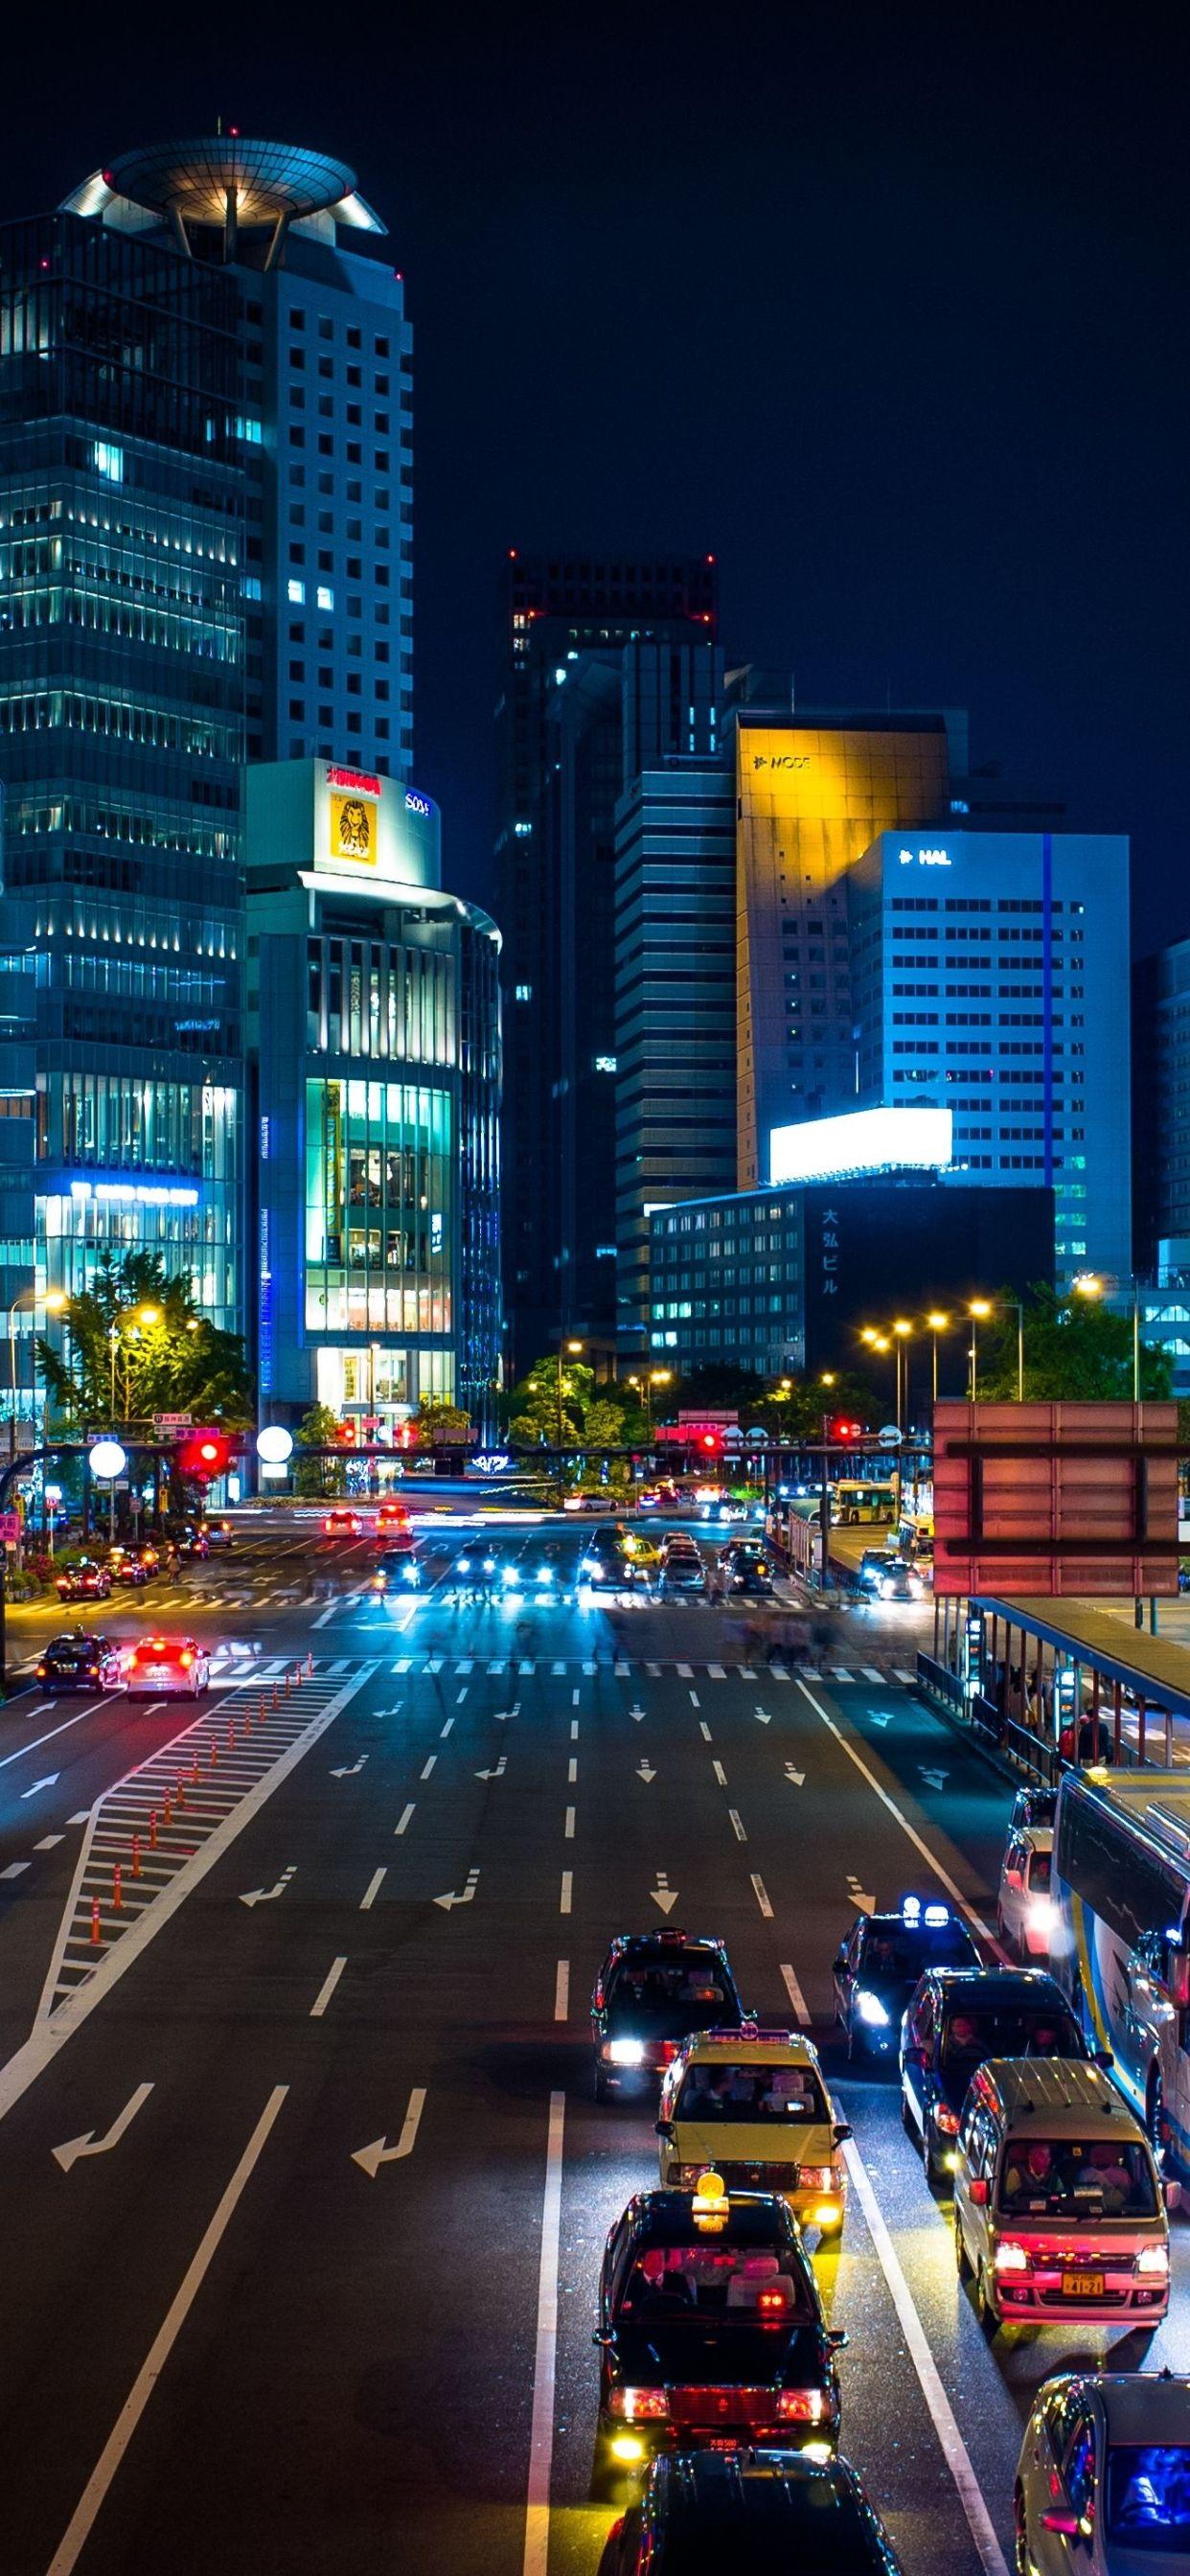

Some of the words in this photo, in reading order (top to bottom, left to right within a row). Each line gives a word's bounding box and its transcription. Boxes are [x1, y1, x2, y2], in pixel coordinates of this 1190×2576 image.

[919, 849, 952, 865] HAL
[822, 1208, 839, 1295] 大弘ビル
